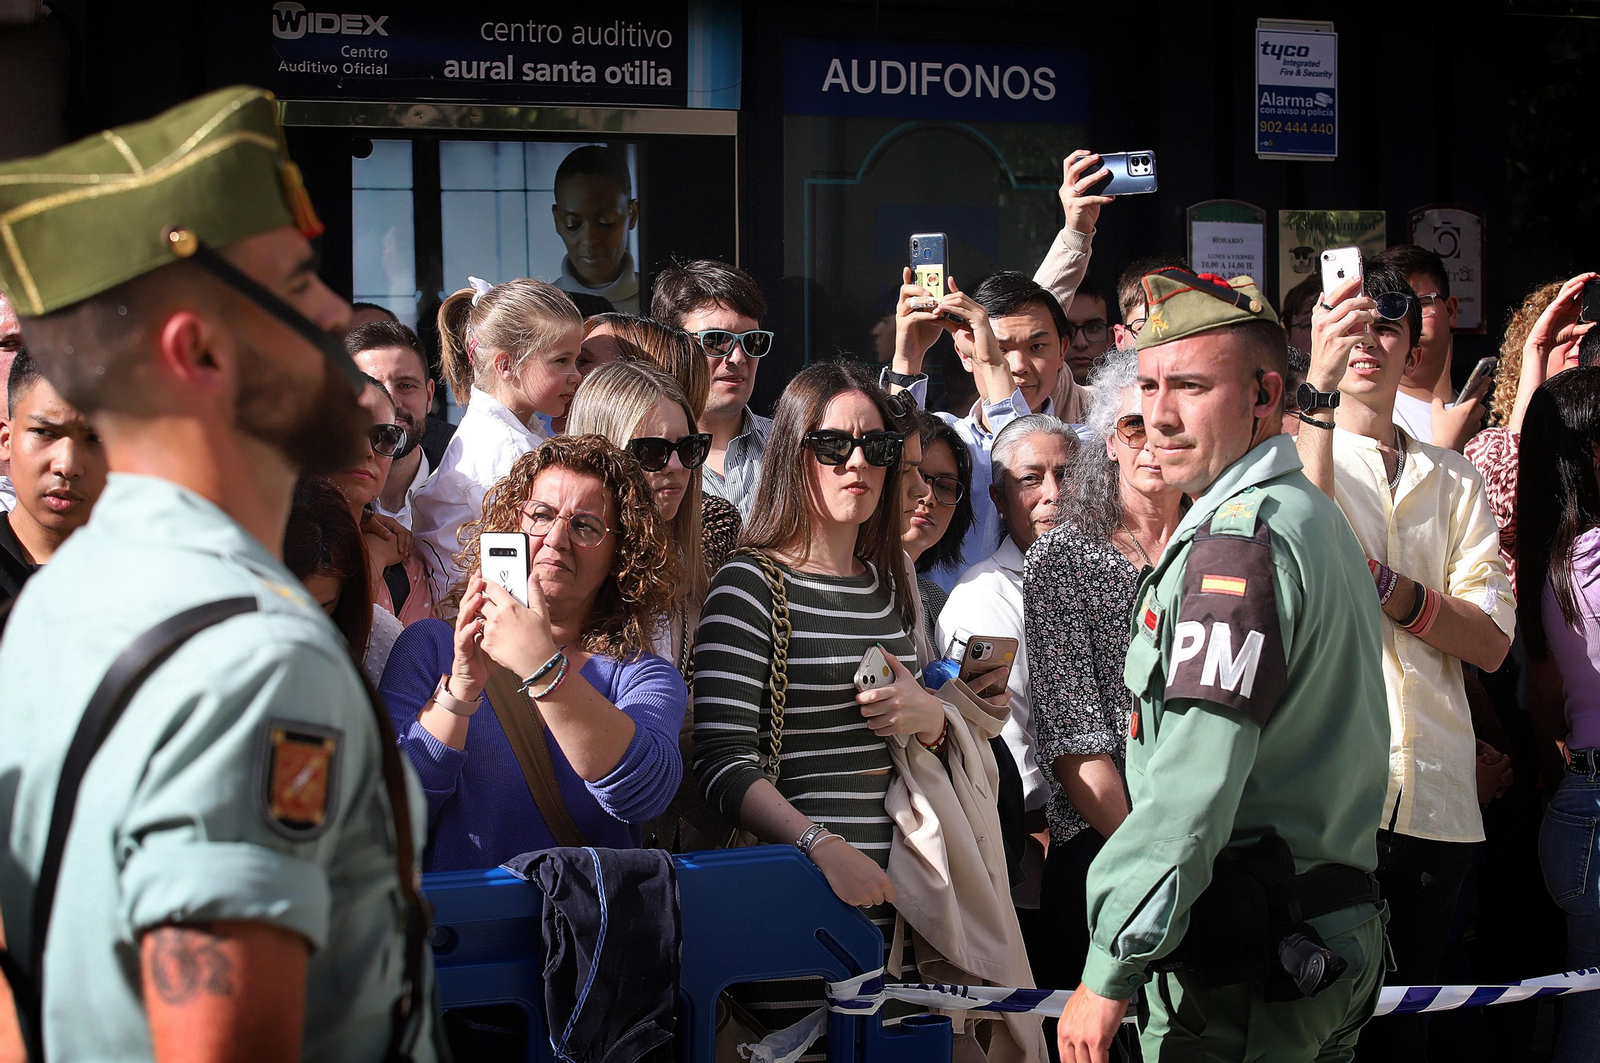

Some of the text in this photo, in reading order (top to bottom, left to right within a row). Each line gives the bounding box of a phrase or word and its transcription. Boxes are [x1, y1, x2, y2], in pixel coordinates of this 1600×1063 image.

[272, 1, 389, 40] WIDEX
[480, 19, 673, 49] centro auditivo
[340, 45, 388, 59] Centro
[1260, 40, 1310, 60] tyco
[278, 60, 388, 75] Auditivo Oficial
[443, 54, 672, 86] aural santa otilia
[1282, 58, 1321, 69] Integrated
[821, 58, 1056, 101] AUDIFONOS
[1280, 67, 1333, 79] Fire & Security
[1260, 91, 1314, 108] Alarma
[1277, 107, 1299, 115] aviso
[1260, 121, 1334, 135] 902 444 440
[1166, 621, 1266, 699] PM
